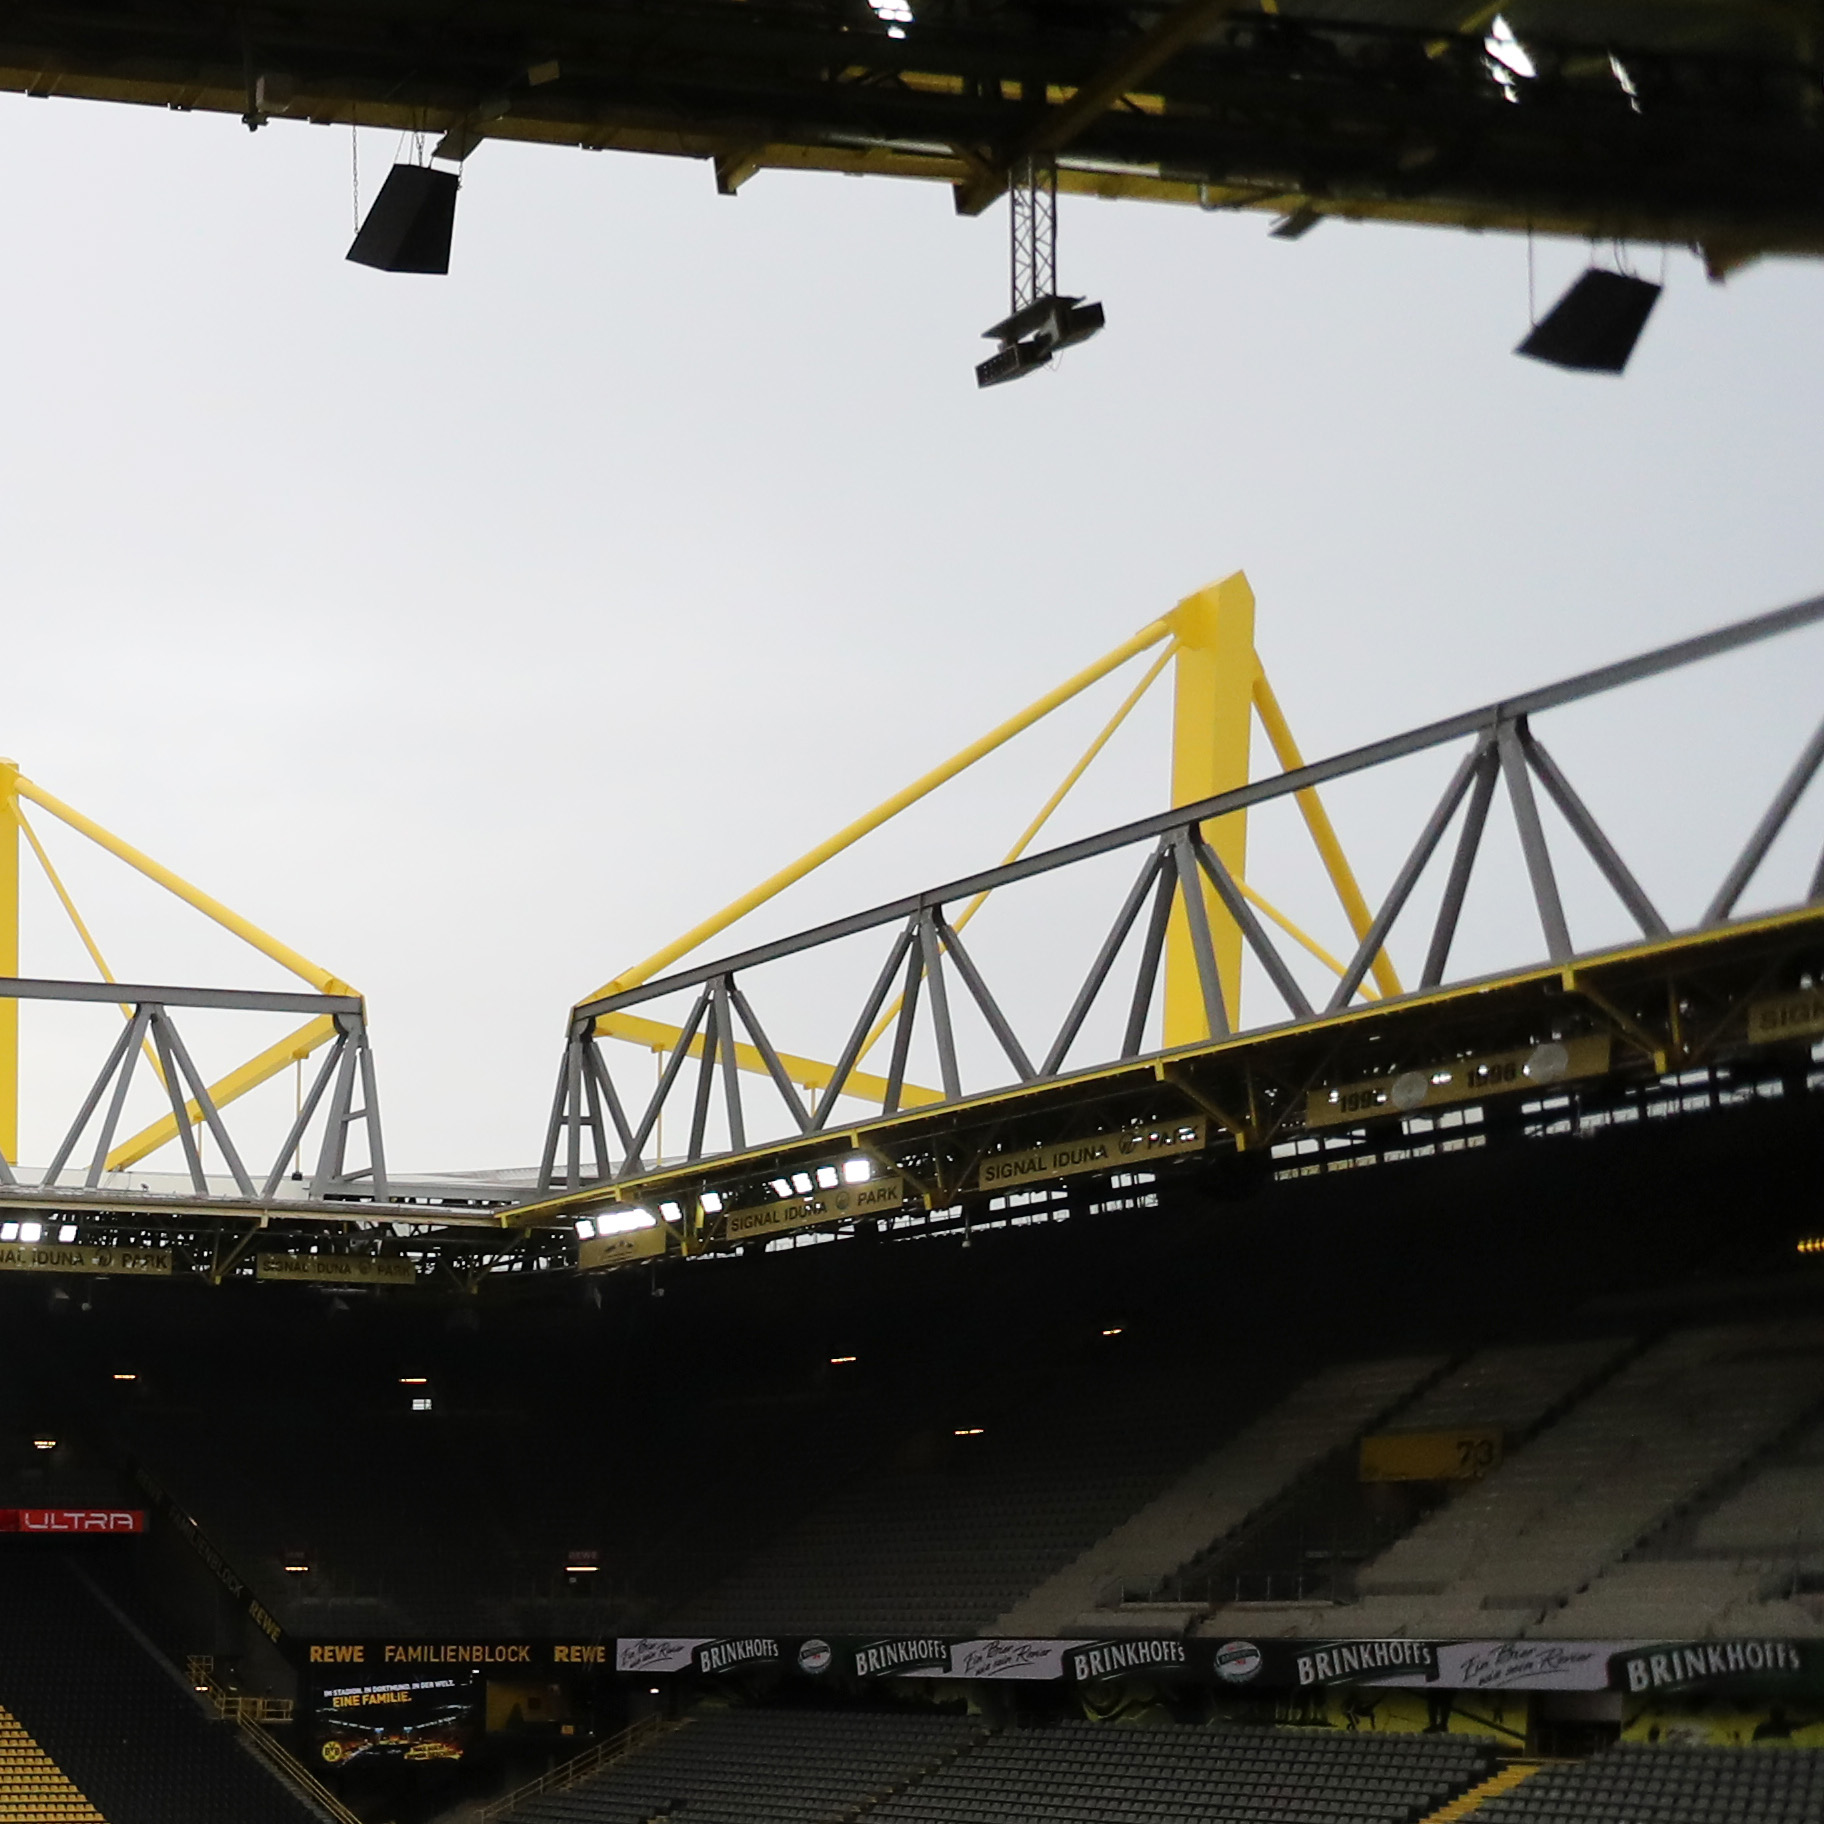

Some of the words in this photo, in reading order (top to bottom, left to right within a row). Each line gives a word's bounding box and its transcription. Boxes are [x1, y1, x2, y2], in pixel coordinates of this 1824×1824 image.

[985, 1154, 1047, 1181] SIGNAL
[1052, 1144, 1109, 1169] IDUNA
[731, 1211, 781, 1232] SIGNAL
[784, 1201, 827, 1221] IDUNA
[857, 1187, 899, 1207] PARK
[122, 1252, 168, 1270] PARK
[1456, 1440, 1494, 1466] 73
[24, 1511, 135, 1529] ULTRA
[248, 1599, 283, 1645] REWE
[309, 1645, 365, 1663] REWE
[383, 1645, 533, 1663] FAMILIENBLOCK
[553, 1645, 607, 1663] REWE
[332, 1694, 360, 1708] EINE
[362, 1691, 413, 1705] FAMILIE.
